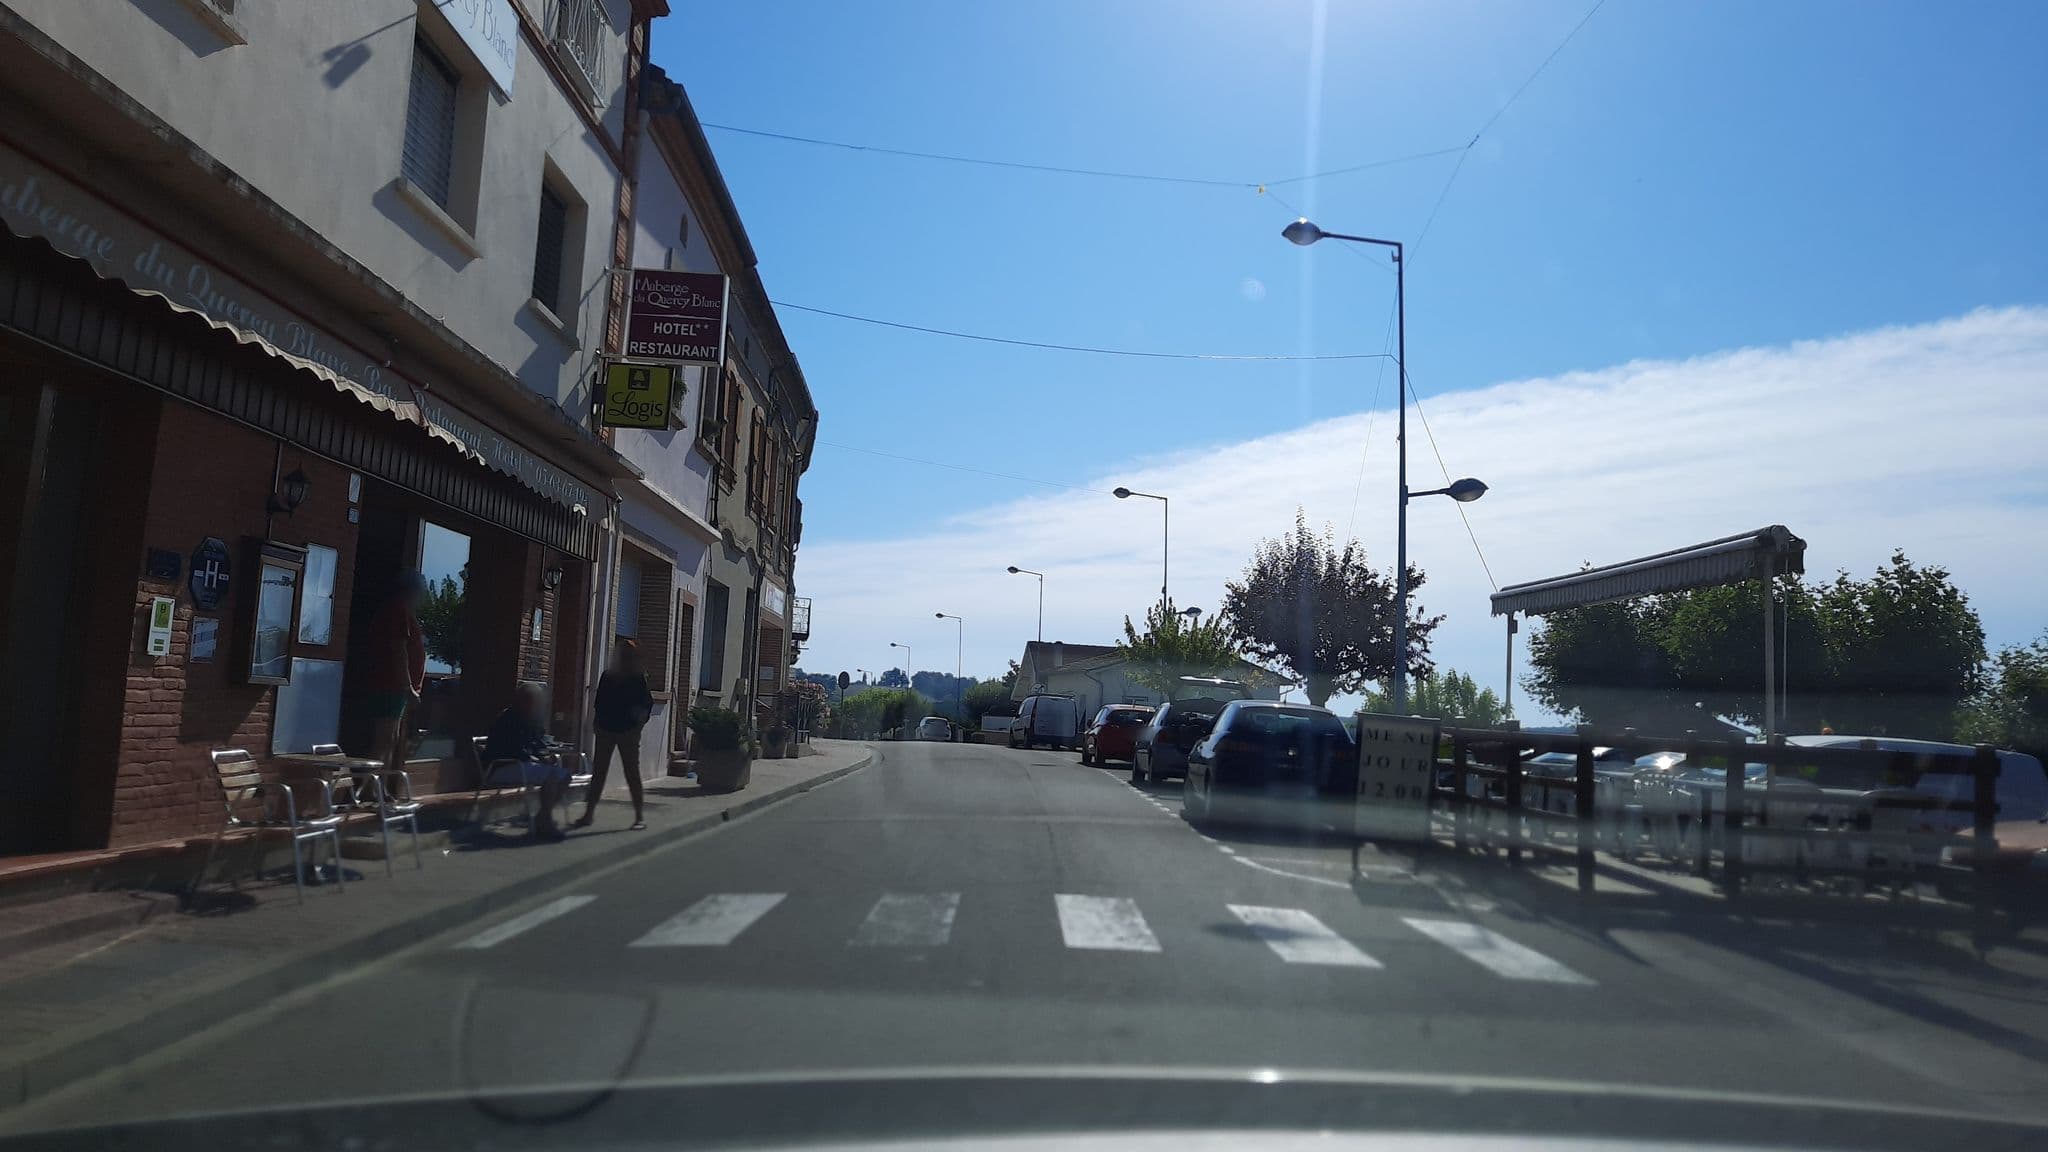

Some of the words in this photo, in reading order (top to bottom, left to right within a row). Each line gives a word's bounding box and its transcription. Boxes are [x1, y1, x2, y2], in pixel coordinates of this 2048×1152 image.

[482, 0, 514, 70] Blanc
[0, 175, 113, 262] uberge
[134, 242, 175, 288] du
[185, 263, 275, 341] Quercy
[285, 322, 350, 374] Blanc
[415, 390, 482, 450] Restaurant
[633, 294, 646, 303] du
[647, 293, 690, 309] Quercy
[691, 294, 721, 309] Blanc
[629, 342, 718, 358] RESTAURANT
[608, 391, 665, 422] Logis
